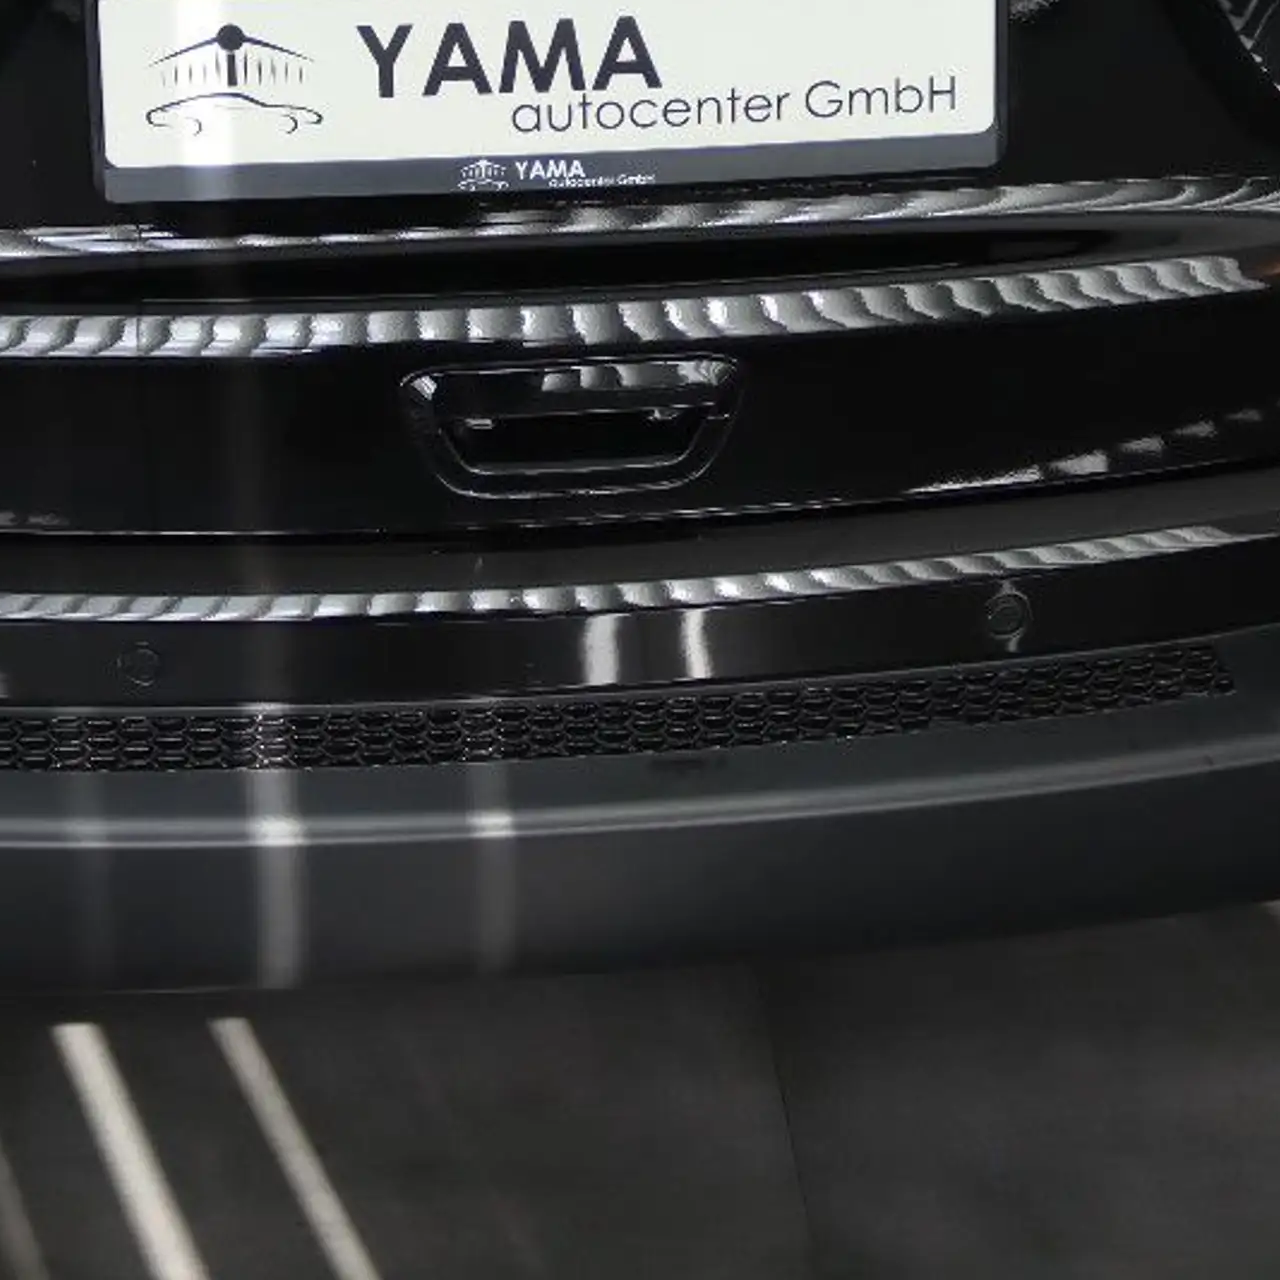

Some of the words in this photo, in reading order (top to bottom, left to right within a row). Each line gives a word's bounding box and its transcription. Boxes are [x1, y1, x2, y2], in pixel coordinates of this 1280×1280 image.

[357, 16, 662, 97] YAMA
[512, 89, 789, 132] autocenter
[805, 76, 957, 117] GmbH
[515, 159, 586, 180] YAMA
